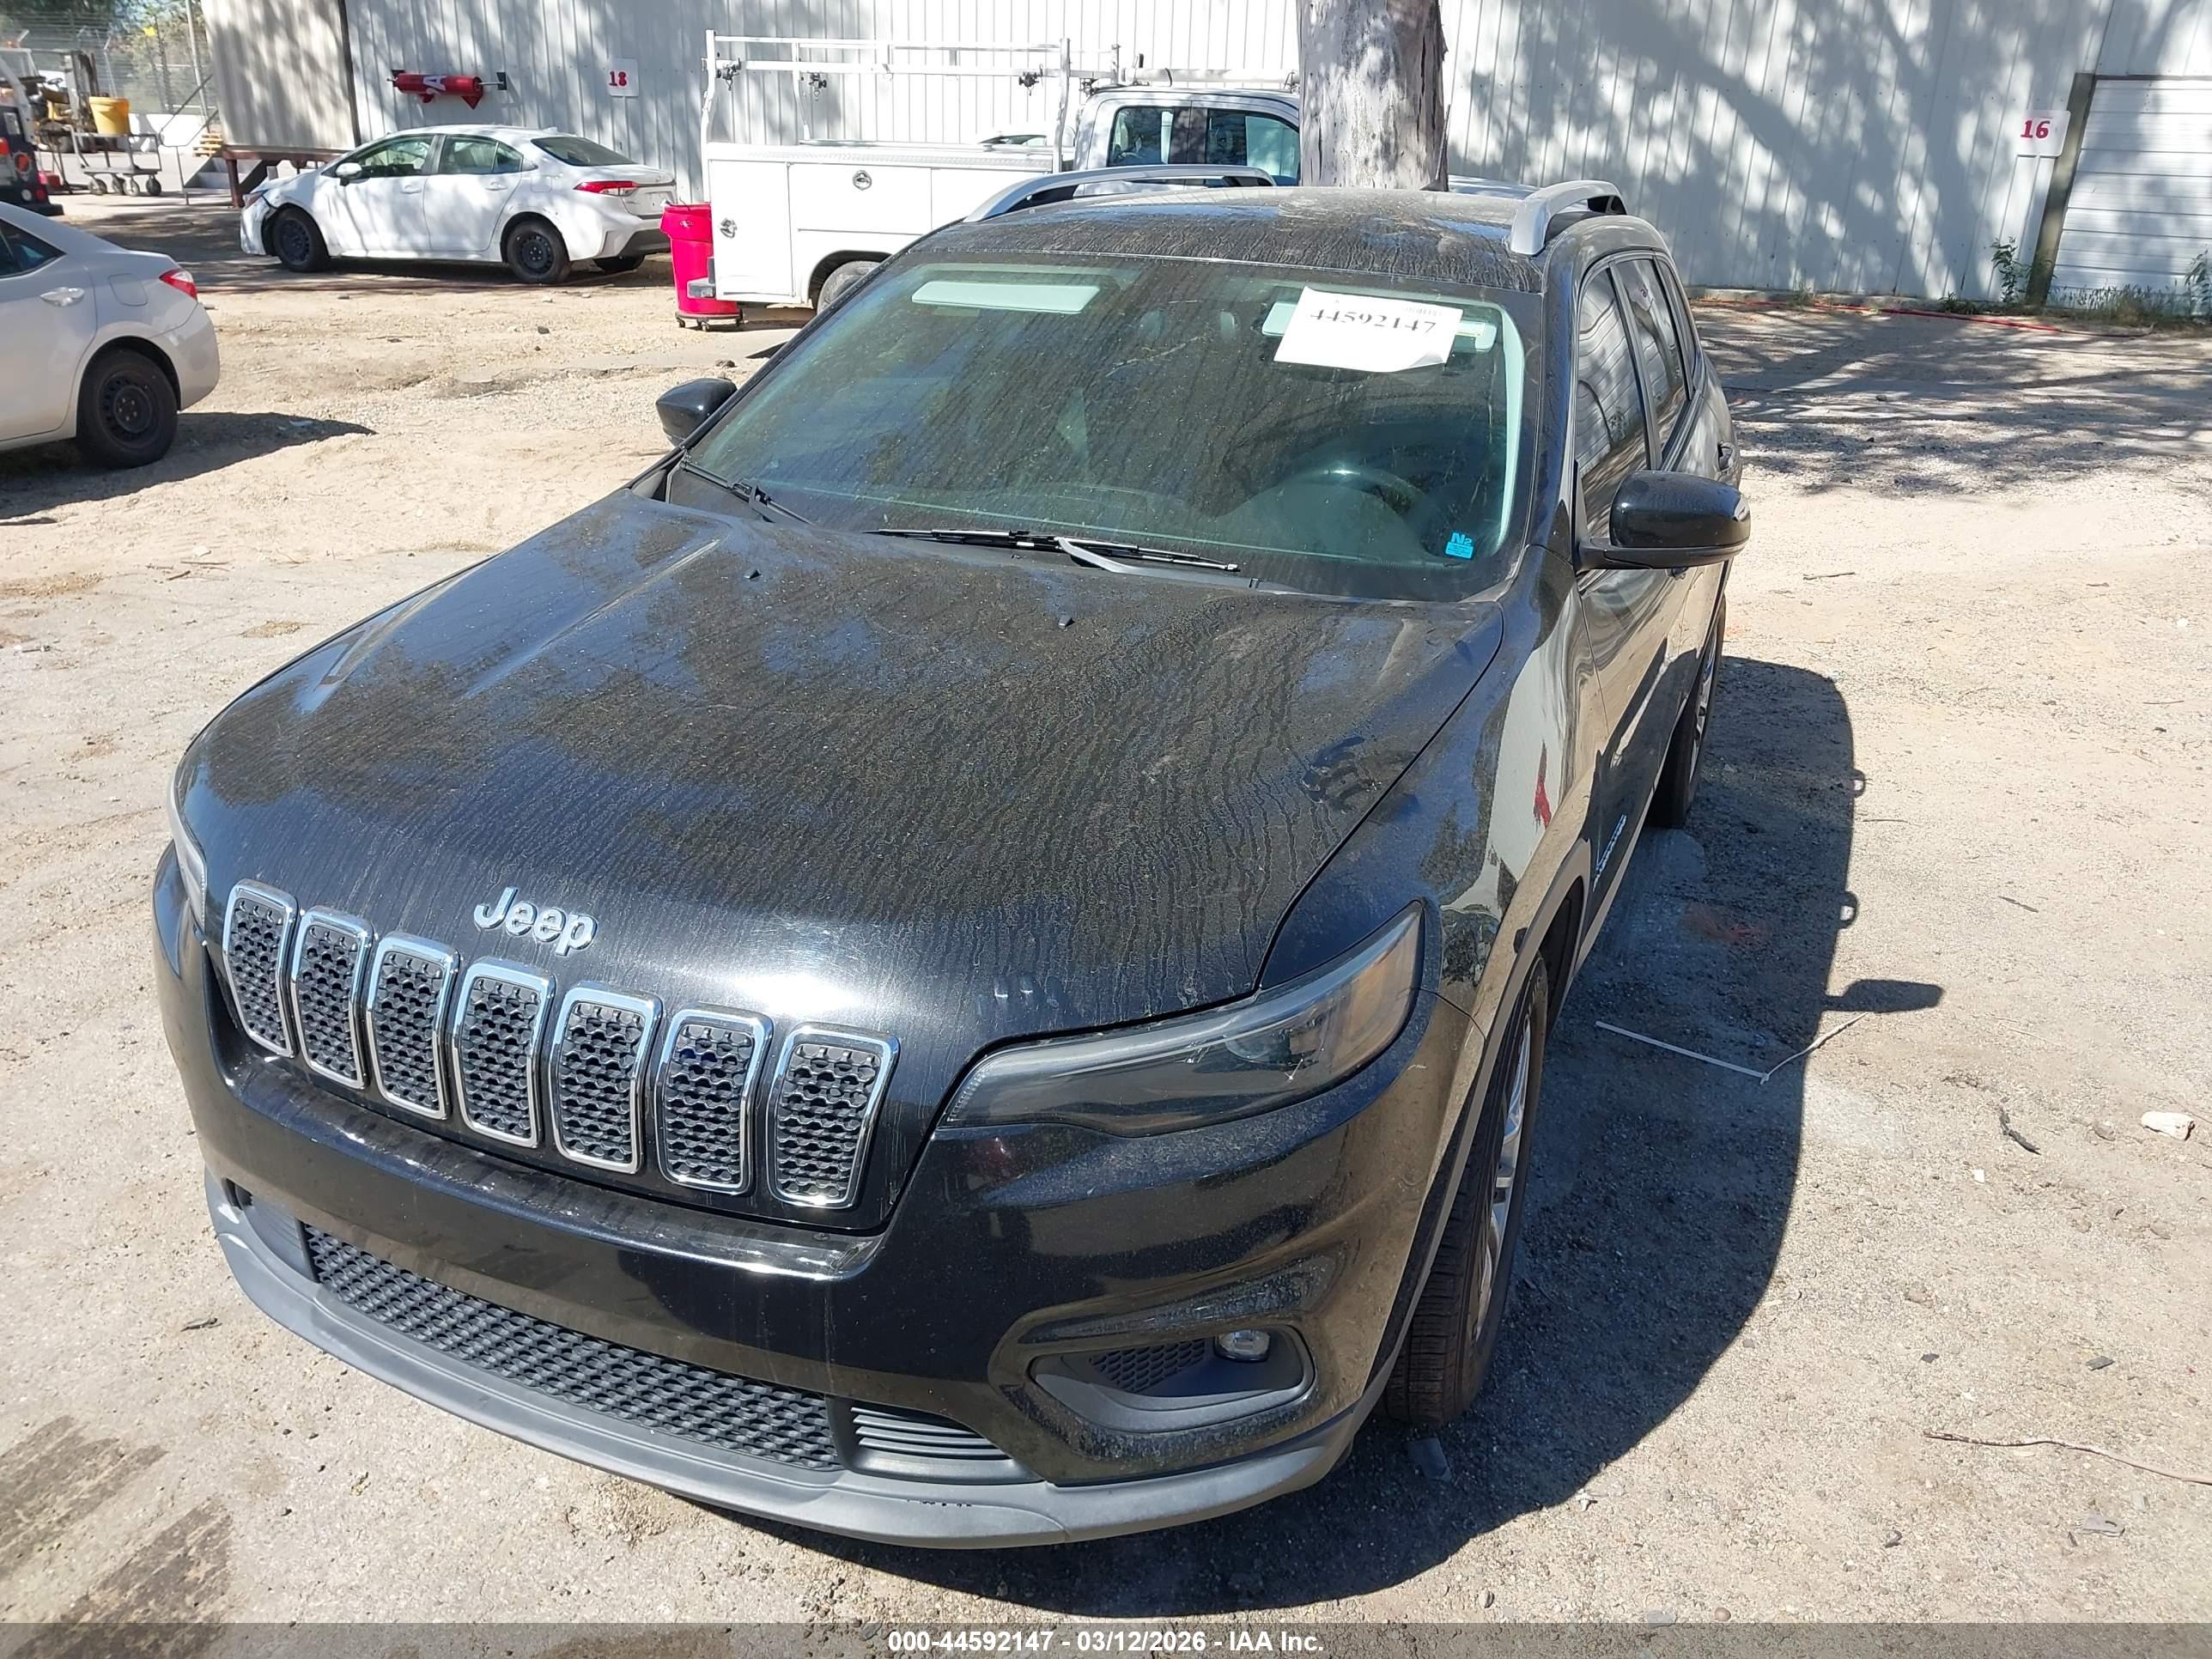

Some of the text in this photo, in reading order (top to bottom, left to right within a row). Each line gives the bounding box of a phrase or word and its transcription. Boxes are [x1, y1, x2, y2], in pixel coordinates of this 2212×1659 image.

[609, 70, 627, 87] 18
[2021, 119, 2051, 139] 16
[1310, 308, 1437, 334] 44592147
[473, 886, 599, 957] Jeep
